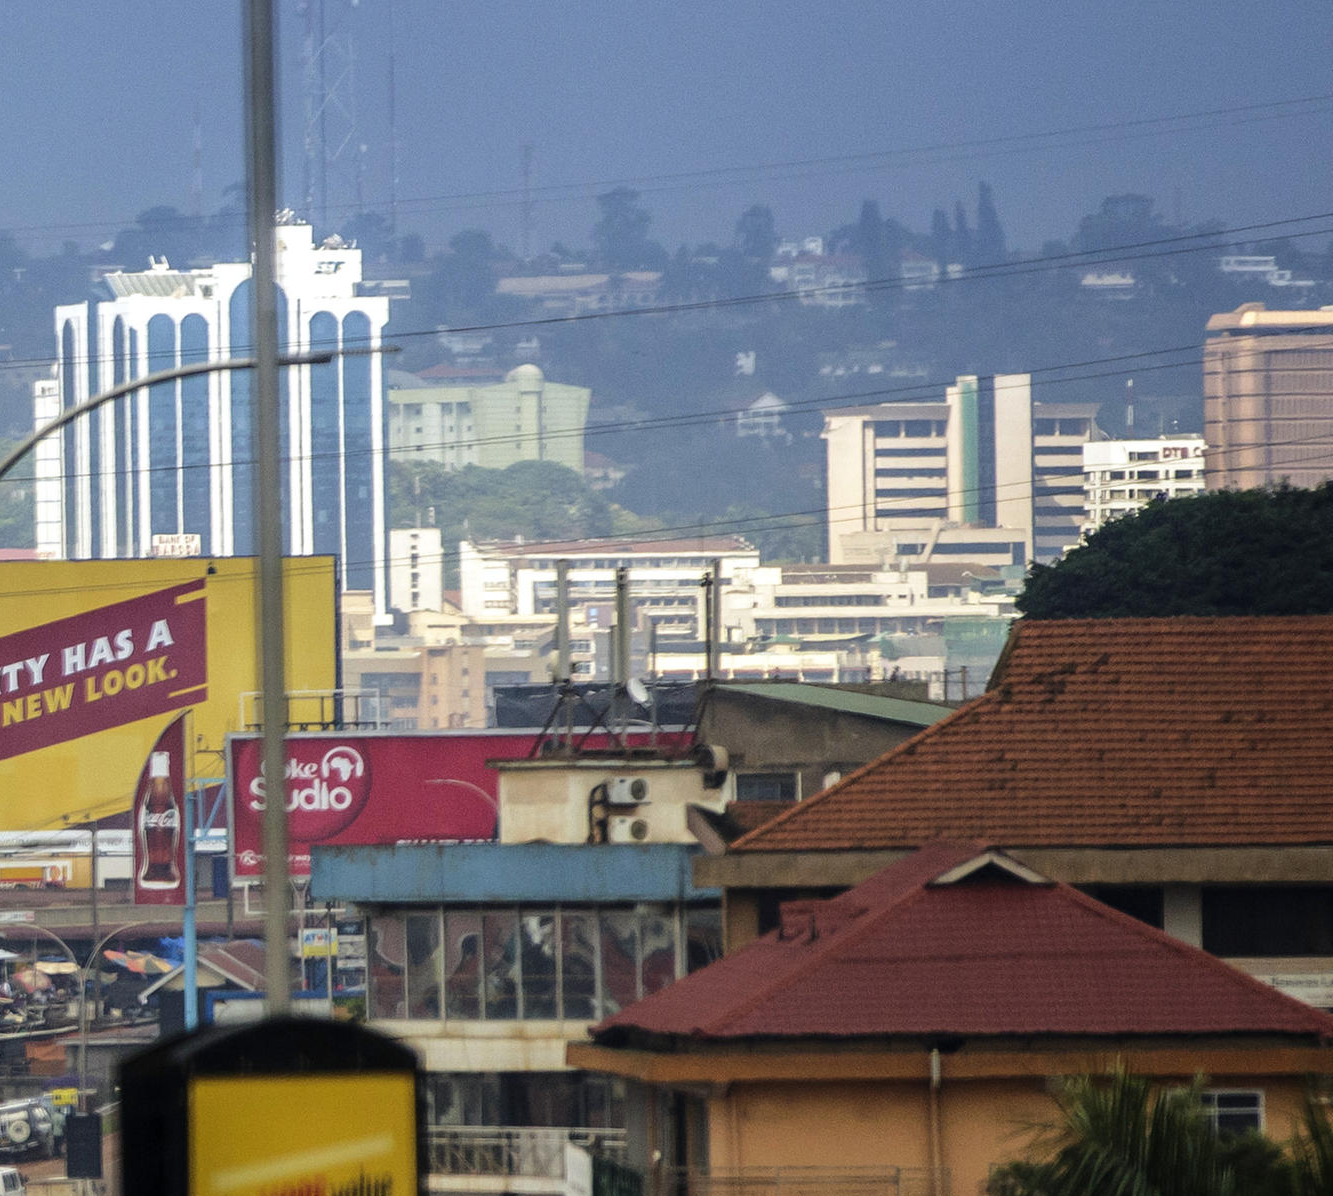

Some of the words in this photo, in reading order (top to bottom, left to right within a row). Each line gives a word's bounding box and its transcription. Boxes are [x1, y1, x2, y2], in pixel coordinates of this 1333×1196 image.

[83, 629, 135, 677] HAS
[144, 618, 175, 652] A
[2, 681, 76, 729] NEW
[85, 655, 179, 704] LOOK.
[249, 778, 353, 812] Sudio
